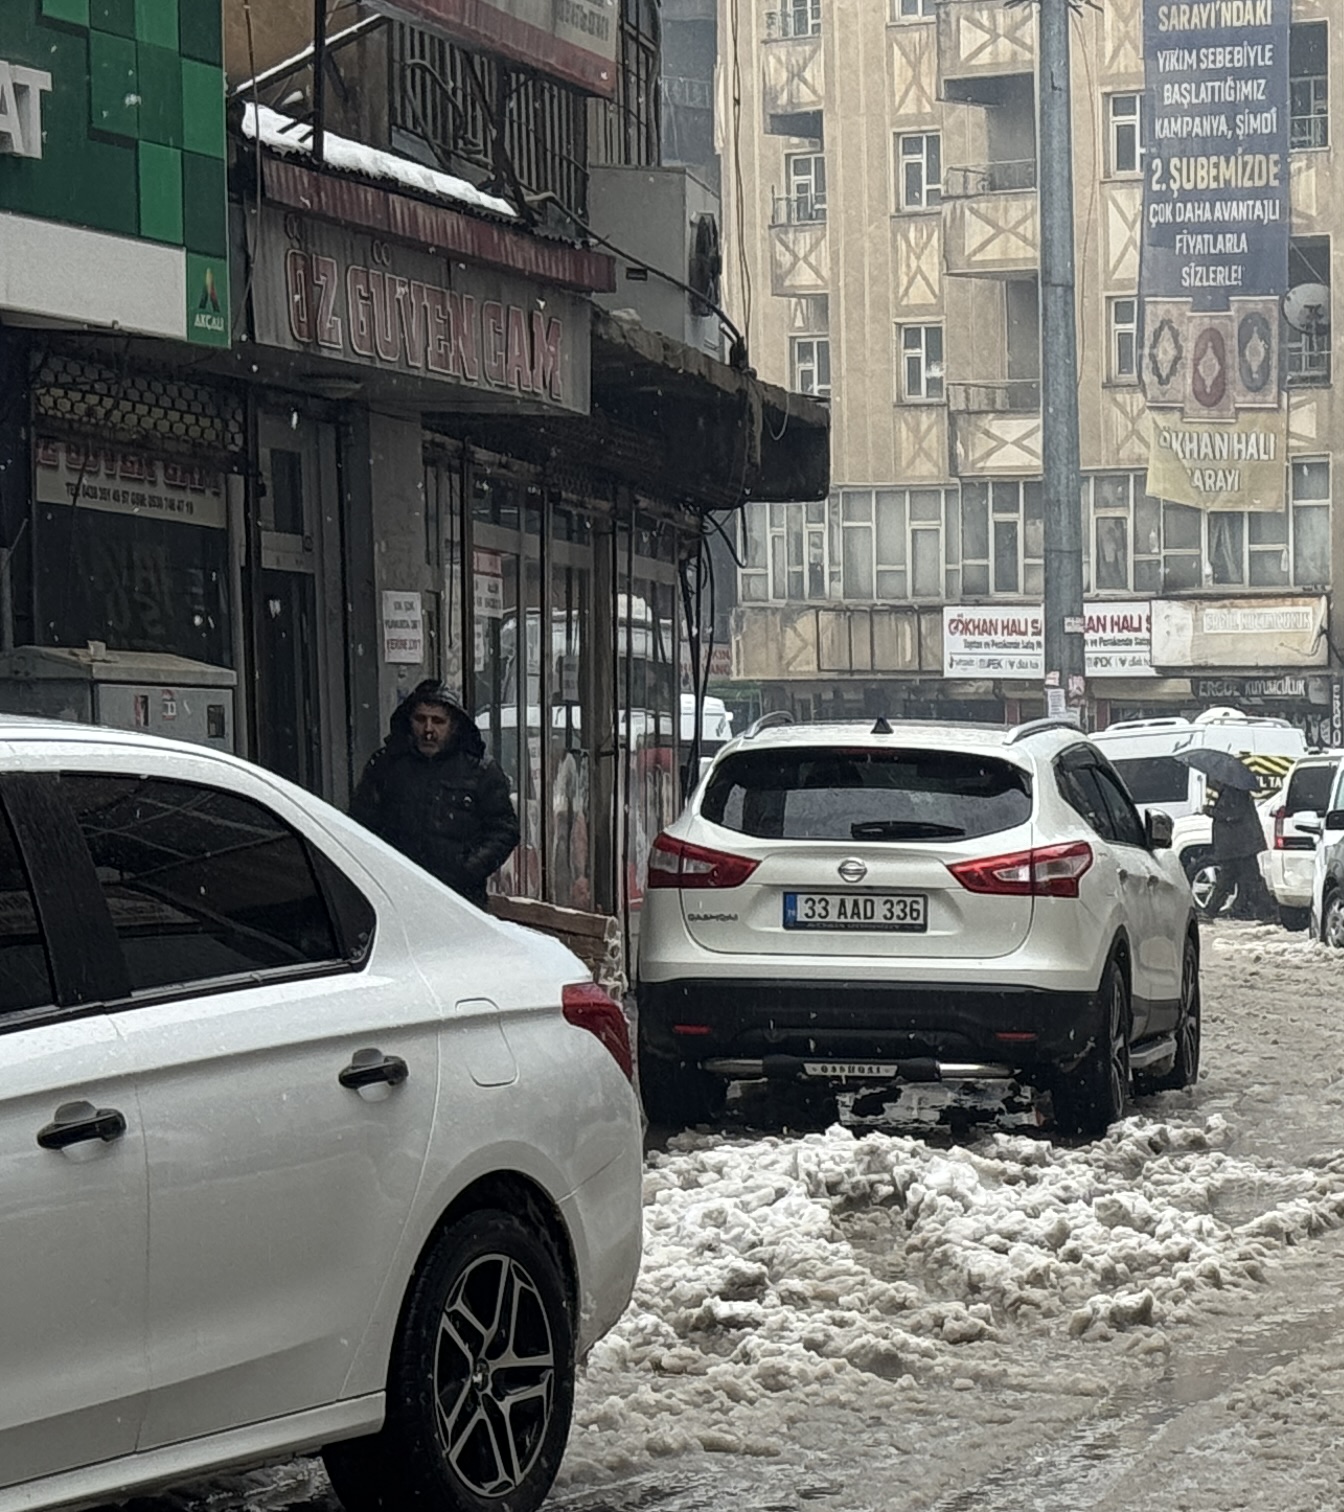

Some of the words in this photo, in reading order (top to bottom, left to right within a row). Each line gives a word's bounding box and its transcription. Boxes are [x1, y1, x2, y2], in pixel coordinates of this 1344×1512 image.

[1157, 48, 1197, 73] YIKIM
[1199, 41, 1274, 70] SEBEBİYLE
[1163, 76, 1267, 109] BAŞLATTIĞIMIZ
[1155, 113, 1233, 139] KAMPANYA,
[1235, 107, 1278, 140] ŞİMDİ
[1151, 157, 1167, 191] 2.
[1169, 147, 1281, 198] ŞUBEMİZDE
[1149, 202, 1173, 228] ÇOK
[1175, 201, 1212, 223] DAHA
[1213, 199, 1280, 226] AVANTAJLI
[1175, 229, 1248, 255] FİYATLARLA
[1181, 263, 1243, 287] SİZLERLE!
[481, 300, 563, 400] CAM
[1158, 426, 1229, 460] ÖKHAN
[1233, 431, 1276, 460] HALI
[1187, 468, 1240, 492] ARAYI
[948, 613, 999, 636] GÖKHAN
[1001, 617, 1029, 636] HALI
[1110, 613, 1142, 634] HALI
[803, 897, 830, 920] 33
[836, 898, 876, 921] AAD
[882, 899, 922, 922] 336
